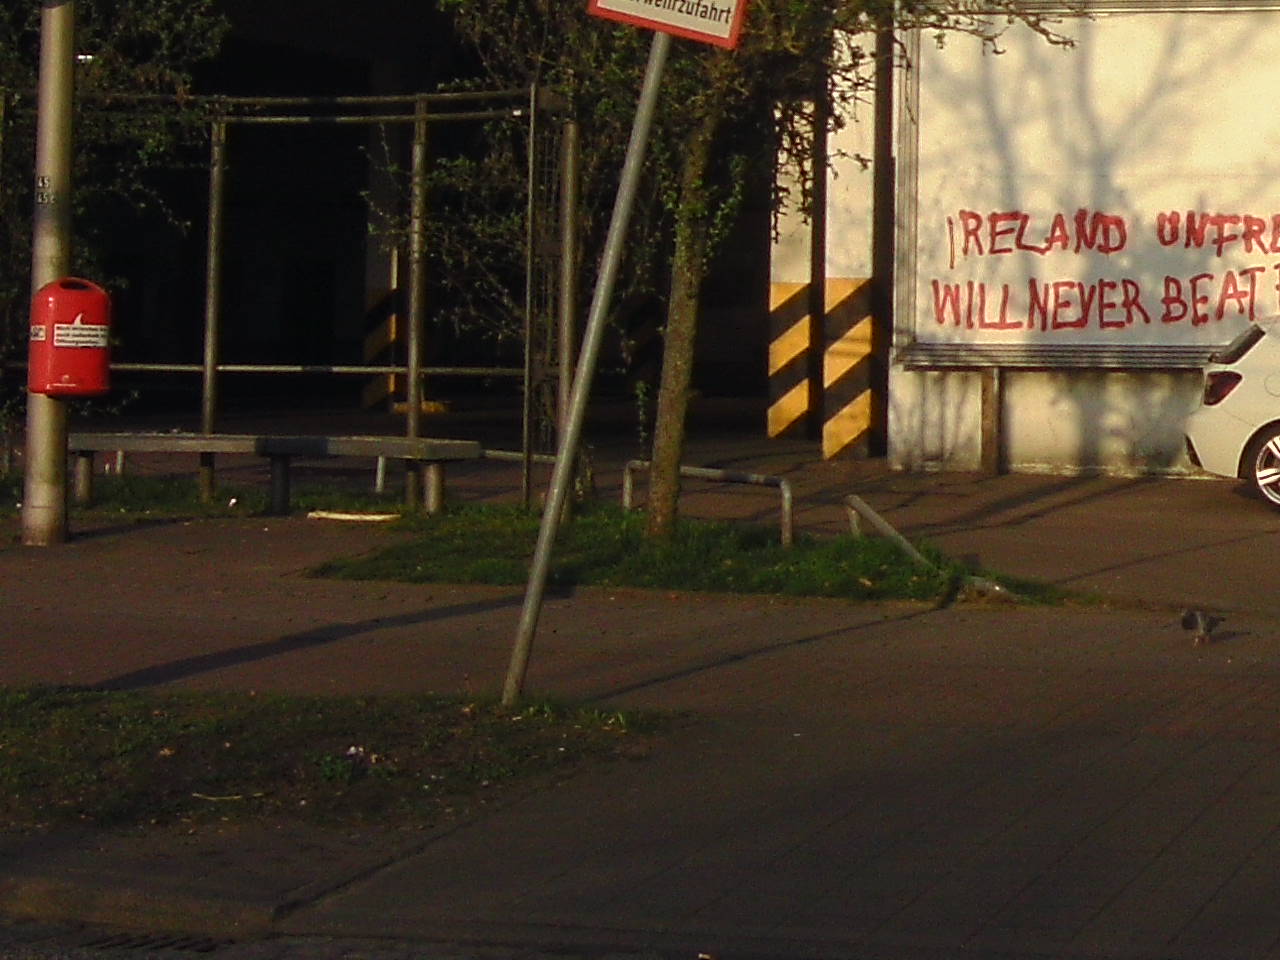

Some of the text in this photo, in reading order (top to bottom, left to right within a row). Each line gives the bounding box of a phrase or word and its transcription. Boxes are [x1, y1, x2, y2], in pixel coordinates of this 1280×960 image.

[947, 208, 1129, 269] IRELAND
[931, 279, 1024, 331] WILL
[1027, 277, 1150, 331] NEVER
[1160, 266, 1266, 327] BEAT
